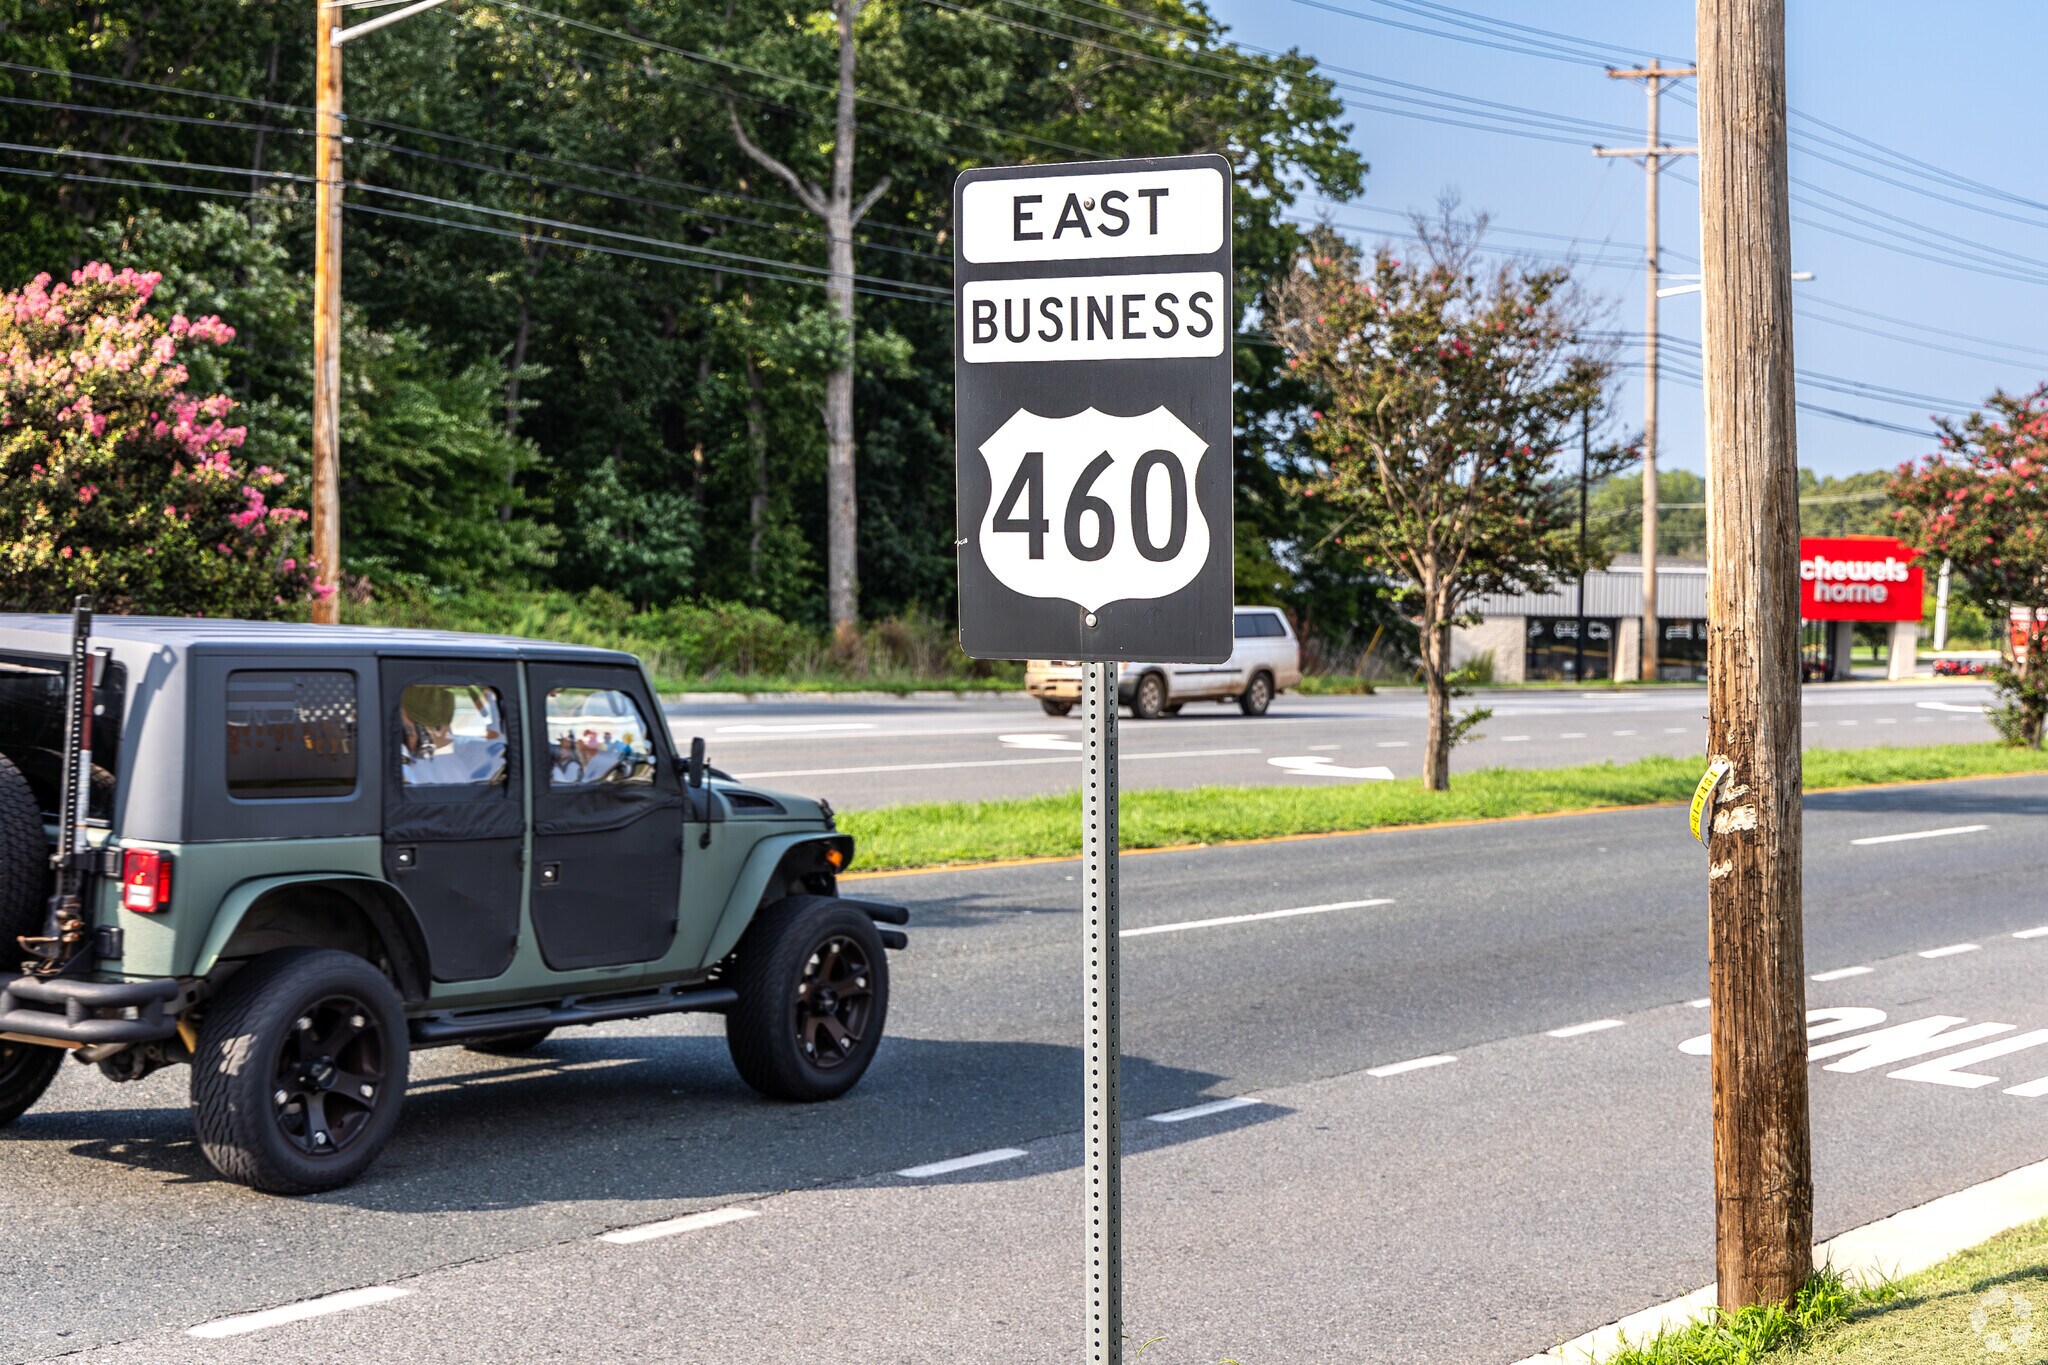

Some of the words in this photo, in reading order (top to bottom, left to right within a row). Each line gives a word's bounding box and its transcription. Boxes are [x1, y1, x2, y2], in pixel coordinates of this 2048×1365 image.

[1013, 187, 1169, 242] EAST
[972, 291, 1214, 344] BUSINESS
[992, 449, 1188, 563] 460
[1800, 555, 1909, 582] chewels
[1814, 579, 1888, 603] home
[1678, 1007, 2048, 1098] ONL
